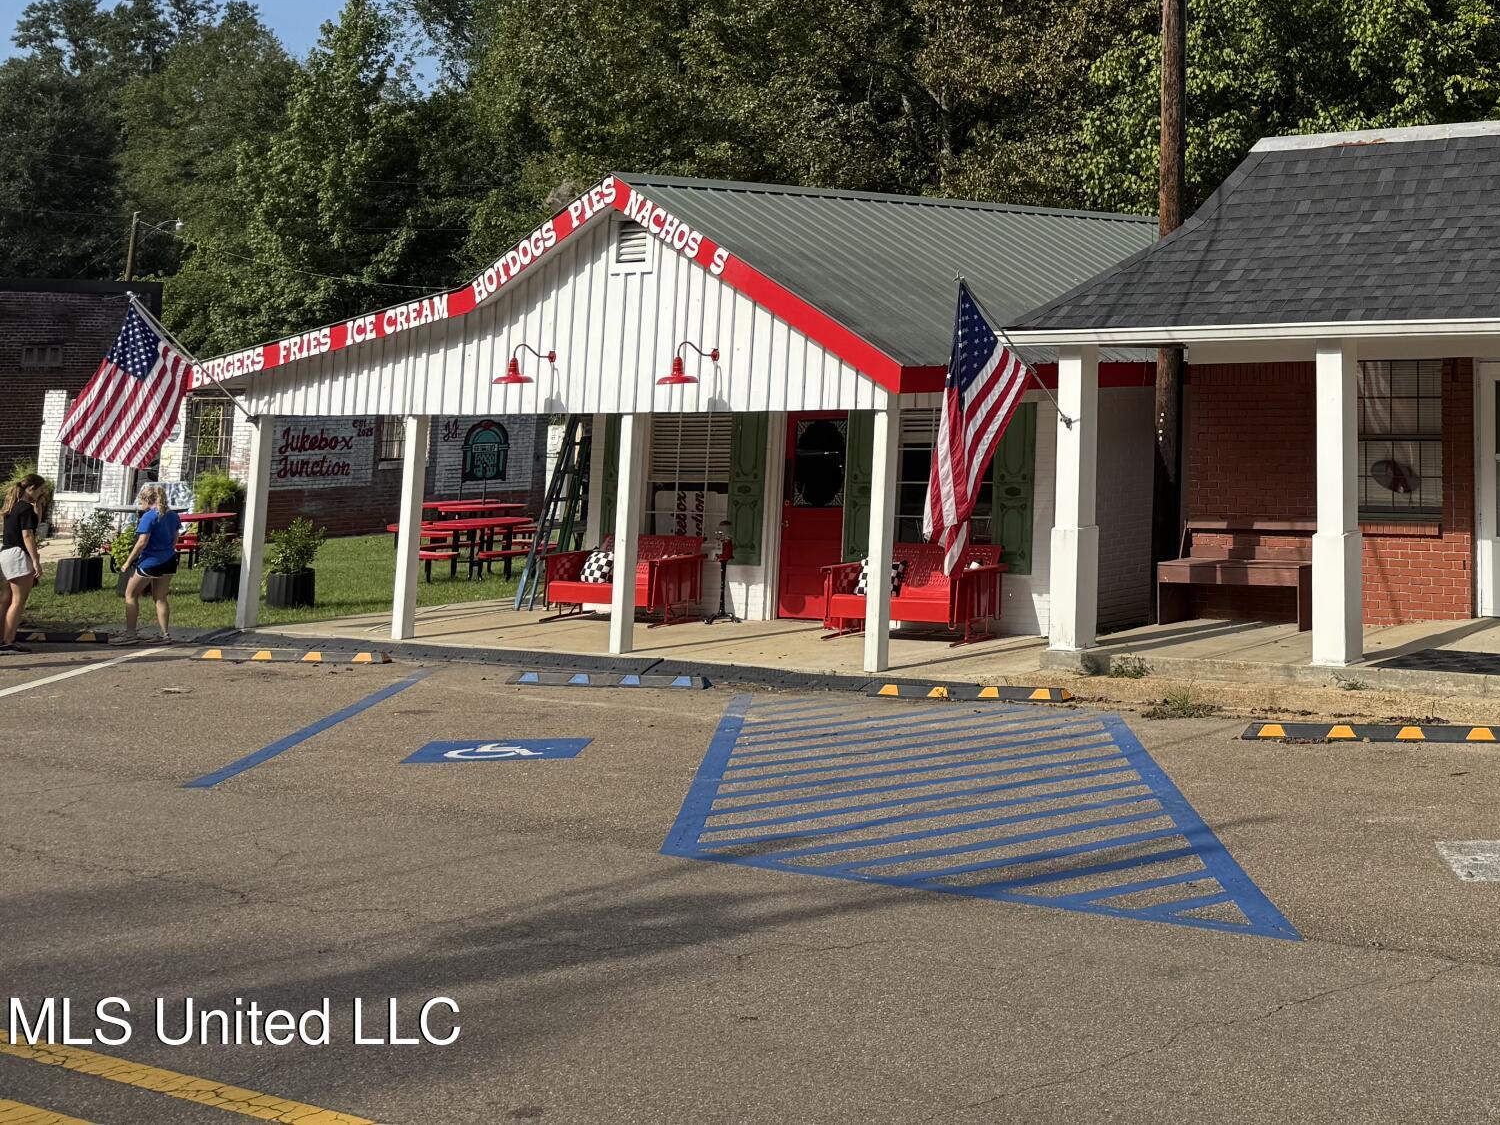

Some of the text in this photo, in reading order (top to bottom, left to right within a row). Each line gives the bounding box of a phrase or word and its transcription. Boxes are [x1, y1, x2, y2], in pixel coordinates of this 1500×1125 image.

[624, 189, 729, 275] NACHOS S
[191, 175, 616, 389] BURGERS FRIES ICE CREAM HOTDOGS PIES
[276, 455, 351, 478] Junction
[278, 426, 354, 454] Jukebox
